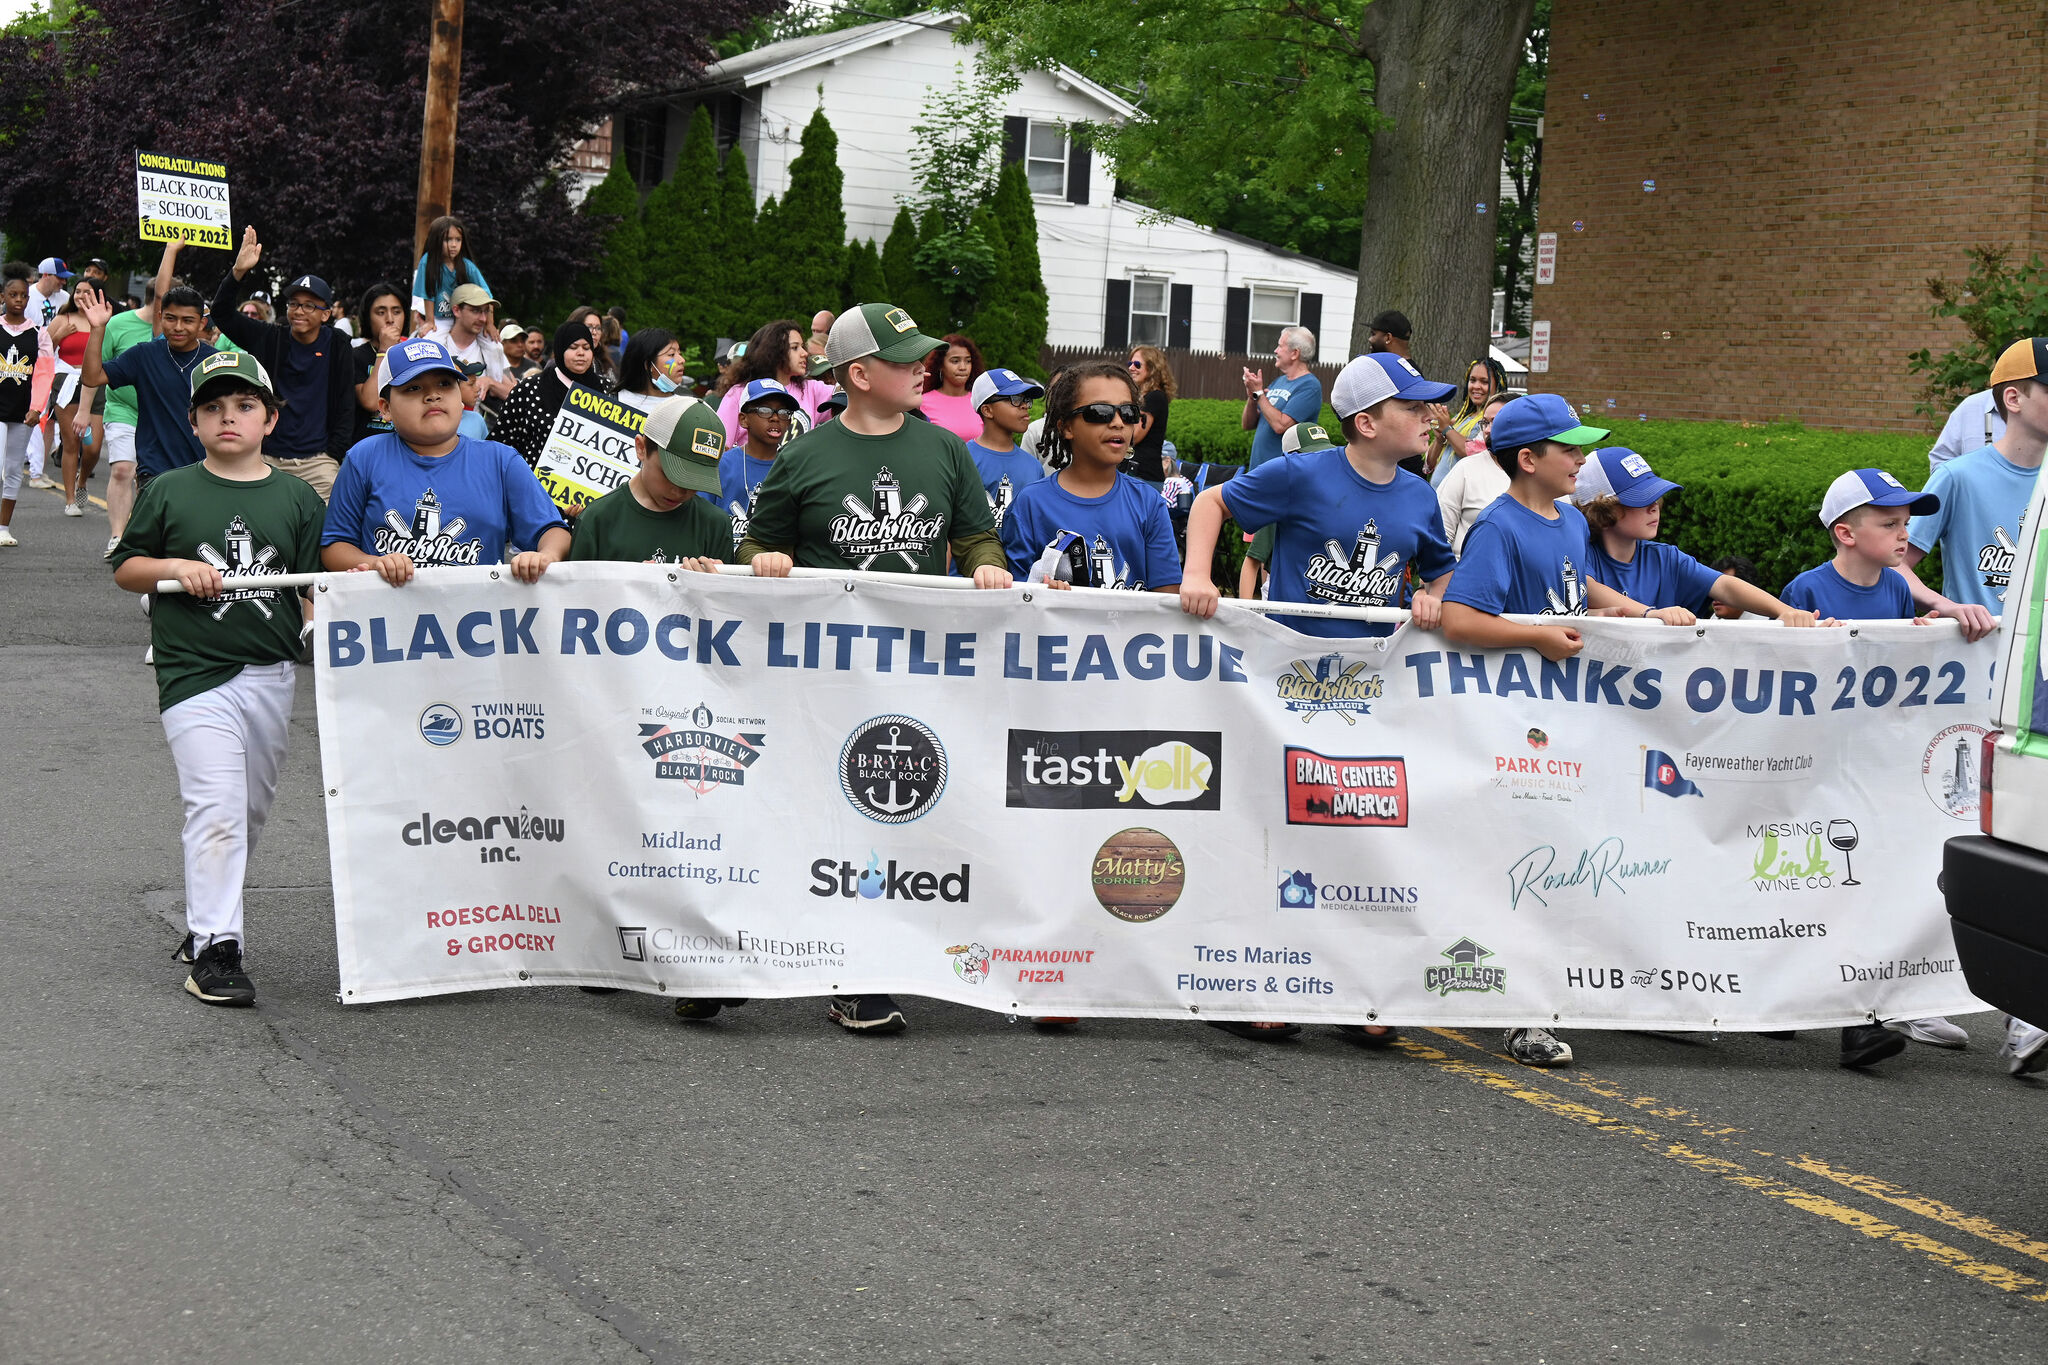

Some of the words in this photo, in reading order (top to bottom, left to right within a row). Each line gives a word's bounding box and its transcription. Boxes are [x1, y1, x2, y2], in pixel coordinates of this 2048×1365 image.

[140, 153, 226, 178] CONGRATULATIONS
[141, 176, 187, 196] BLACK
[190, 183, 227, 201] ROCK
[159, 200, 212, 221] SCHOOL
[144, 223, 179, 239] CLASS
[182, 228, 196, 241] OF
[199, 229, 228, 245] 2022
[300, 276, 311, 288] A
[555, 415, 635, 465] BLACK
[831, 514, 892, 542] Black
[898, 513, 943, 538] Rock
[375, 528, 430, 560] Black
[432, 536, 483, 564] Rock
[850, 544, 886, 553] LITTLE
[888, 542, 923, 551] LEAGUE
[1979, 545, 2015, 572] Bla
[1306, 556, 1365, 590] Black
[242, 590, 275, 599] LEAGUE
[1315, 587, 1350, 602] LITTLE
[1352, 595, 1385, 606] LEAGUE
[328, 607, 540, 668] BLACK
[560, 607, 743, 666] ROCK
[767, 622, 977, 677] LITTLE
[1003, 632, 1248, 684] LEAGUE
[1277, 674, 1333, 701] Black
[1334, 674, 1384, 700] Rock
[1405, 651, 1662, 710] THANKS
[1684, 666, 1819, 716] OUR
[1830, 660, 1967, 711] 2022
[472, 703, 513, 717] TWIN
[517, 703, 545, 717] HULL
[641, 708, 653, 716] THE
[655, 705, 690, 720] Original
[716, 716, 736, 724] SOCIAL
[737, 718, 766, 726] NETWORK
[1294, 701, 1325, 711] LITTLE
[1327, 701, 1364, 711] LEAGUE
[473, 717, 545, 740] BOATS
[653, 732, 750, 761] HARBORVIEW
[1035, 737, 1059, 756] the
[1922, 748, 1934, 774] BLACK
[1931, 731, 1948, 748] ROCK
[1296, 758, 1338, 785] BRAKE
[1340, 765, 1398, 788] CENTERS
[1495, 756, 1541, 774] PARK
[1546, 760, 1582, 778] CITY
[1685, 752, 1765, 771] Fayerweather
[1767, 757, 1793, 772] Yacht
[1795, 755, 1813, 770] Club
[661, 765, 696, 777] BLACK
[712, 768, 737, 782] ROCK
[859, 769, 891, 780] BLACK
[898, 771, 928, 781] ROCK
[1549, 781, 1573, 792] HALL
[1333, 792, 1399, 818] AMERICA
[402, 806, 565, 847] clearview
[1746, 820, 1823, 839] MISSING
[641, 832, 722, 851] Midland
[480, 846, 521, 864] inc.
[1748, 832, 1835, 882] link
[607, 861, 723, 885] Contracting,
[728, 866, 760, 884] LLC
[808, 856, 971, 904] Stoked
[1093, 857, 1182, 885] Matty's
[1093, 877, 1150, 885] CORNER
[1508, 844, 1589, 911] Road
[1589, 836, 1672, 898] Runner
[1320, 884, 1418, 904] COLLINS
[1754, 877, 1801, 892] WINE
[1806, 876, 1836, 890] CO.
[427, 904, 525, 929] ROESCAL
[528, 905, 561, 924] DELI
[1112, 906, 1133, 919] BLACK
[1155, 906, 1165, 915] CT
[1686, 918, 1827, 941] Framemakers
[447, 939, 462, 956] &
[468, 933, 556, 954] GROCERY
[1194, 945, 1238, 963] Tres
[1244, 946, 1313, 965] Marias
[653, 955, 725, 964] ACCOUNTING
[740, 956, 759, 964] TAX
[772, 958, 844, 969] CONSULTING
[991, 948, 1095, 964] PARAMOUNT
[1018, 969, 1065, 983] PIZZA
[1426, 966, 1505, 991] COLLEGE
[1566, 967, 1624, 990] HUB
[1630, 967, 1658, 988] and
[1660, 970, 1742, 994] SPOKE
[1839, 961, 1893, 982] David
[1897, 957, 1955, 979] Barbour
[1177, 974, 1257, 993] Flowers
[1263, 976, 1279, 993] &
[1285, 976, 1334, 995] Gifts
[1441, 977, 1489, 996] Promo
